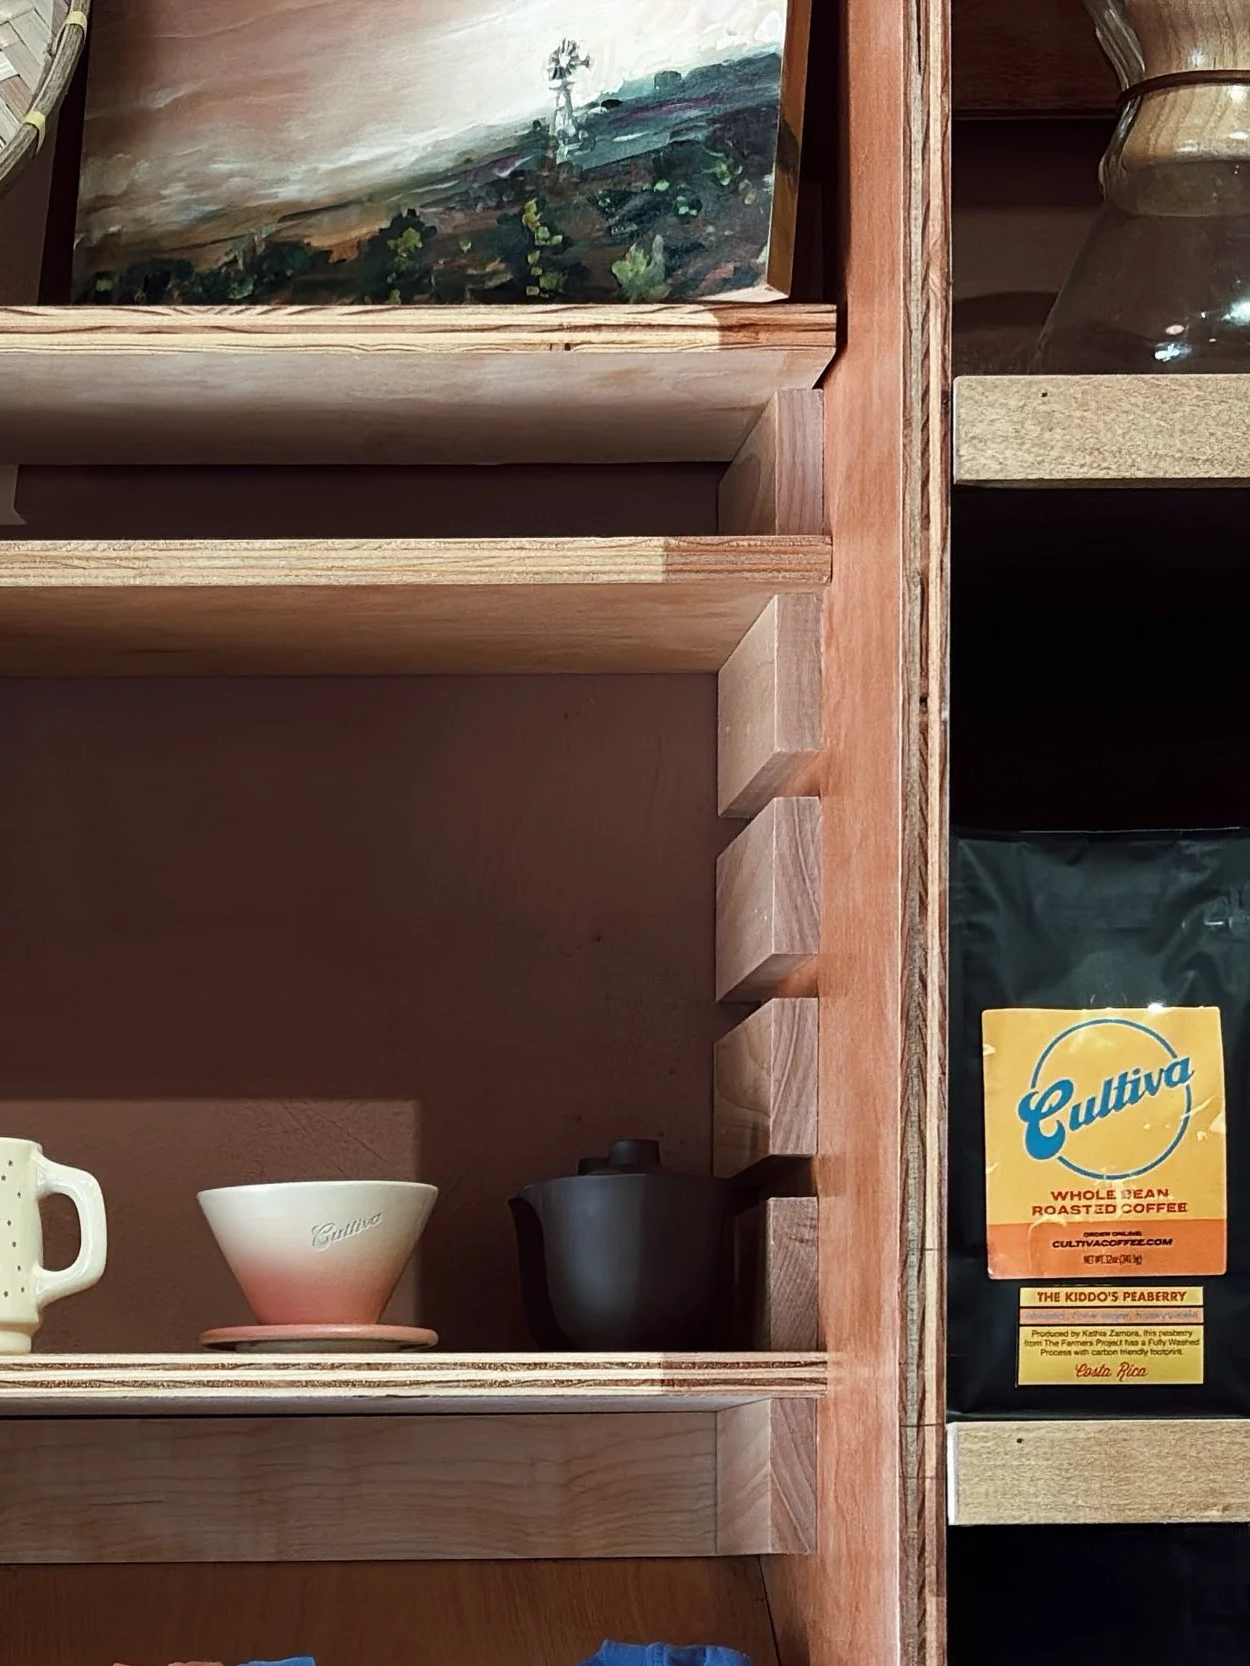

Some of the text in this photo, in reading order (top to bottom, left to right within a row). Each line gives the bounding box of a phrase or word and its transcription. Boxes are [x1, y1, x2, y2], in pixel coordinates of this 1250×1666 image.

[1017, 1057, 1195, 1160] Cultiva
[1050, 1188, 1169, 1201] WHOLE BEAN
[1031, 1202, 1188, 1217] ROASTED COFFEE
[311, 1212, 382, 1252] Cultiva
[1052, 1238, 1173, 1248] CULTIVACOFFEE.COM
[1037, 1291, 1187, 1303] THE KIDDO'S PEABERRY
[1031, 1329, 1069, 1338] Produced
[1071, 1330, 1080, 1339] by
[1043, 1339, 1060, 1347] The
[1060, 1339, 1094, 1347] Farmers
[1095, 1339, 1123, 1348] Project
[1040, 1349, 1072, 1357] Process
[1075, 1361, 1148, 1383] Costa Rica
